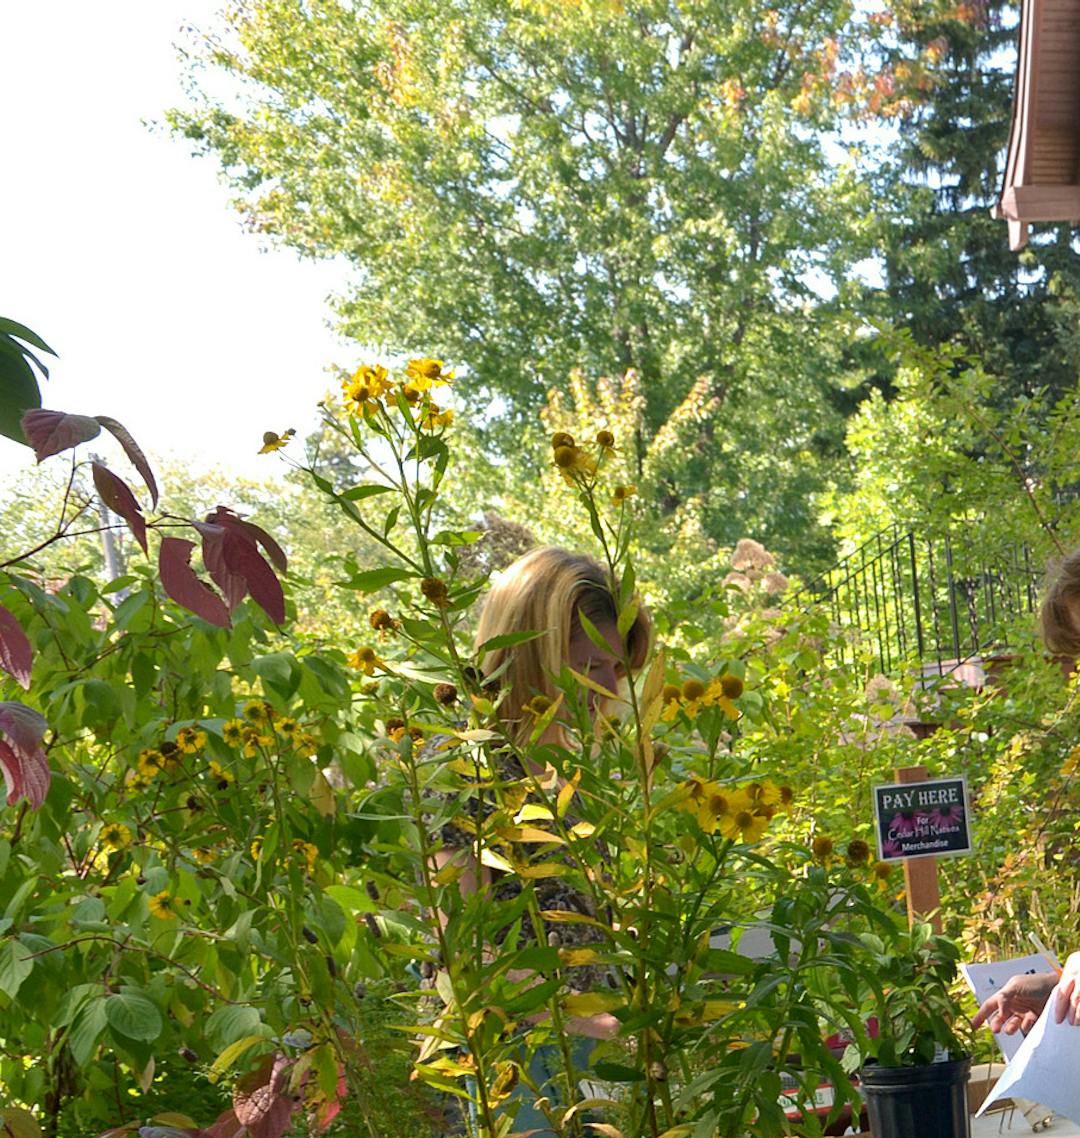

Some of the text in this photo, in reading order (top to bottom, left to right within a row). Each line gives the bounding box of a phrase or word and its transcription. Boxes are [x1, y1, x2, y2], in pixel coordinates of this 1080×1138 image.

[883, 788, 958, 809] PAY HERE
[888, 824, 960, 841] Cedar Hill Natives
[902, 840, 948, 852] Merchandise
